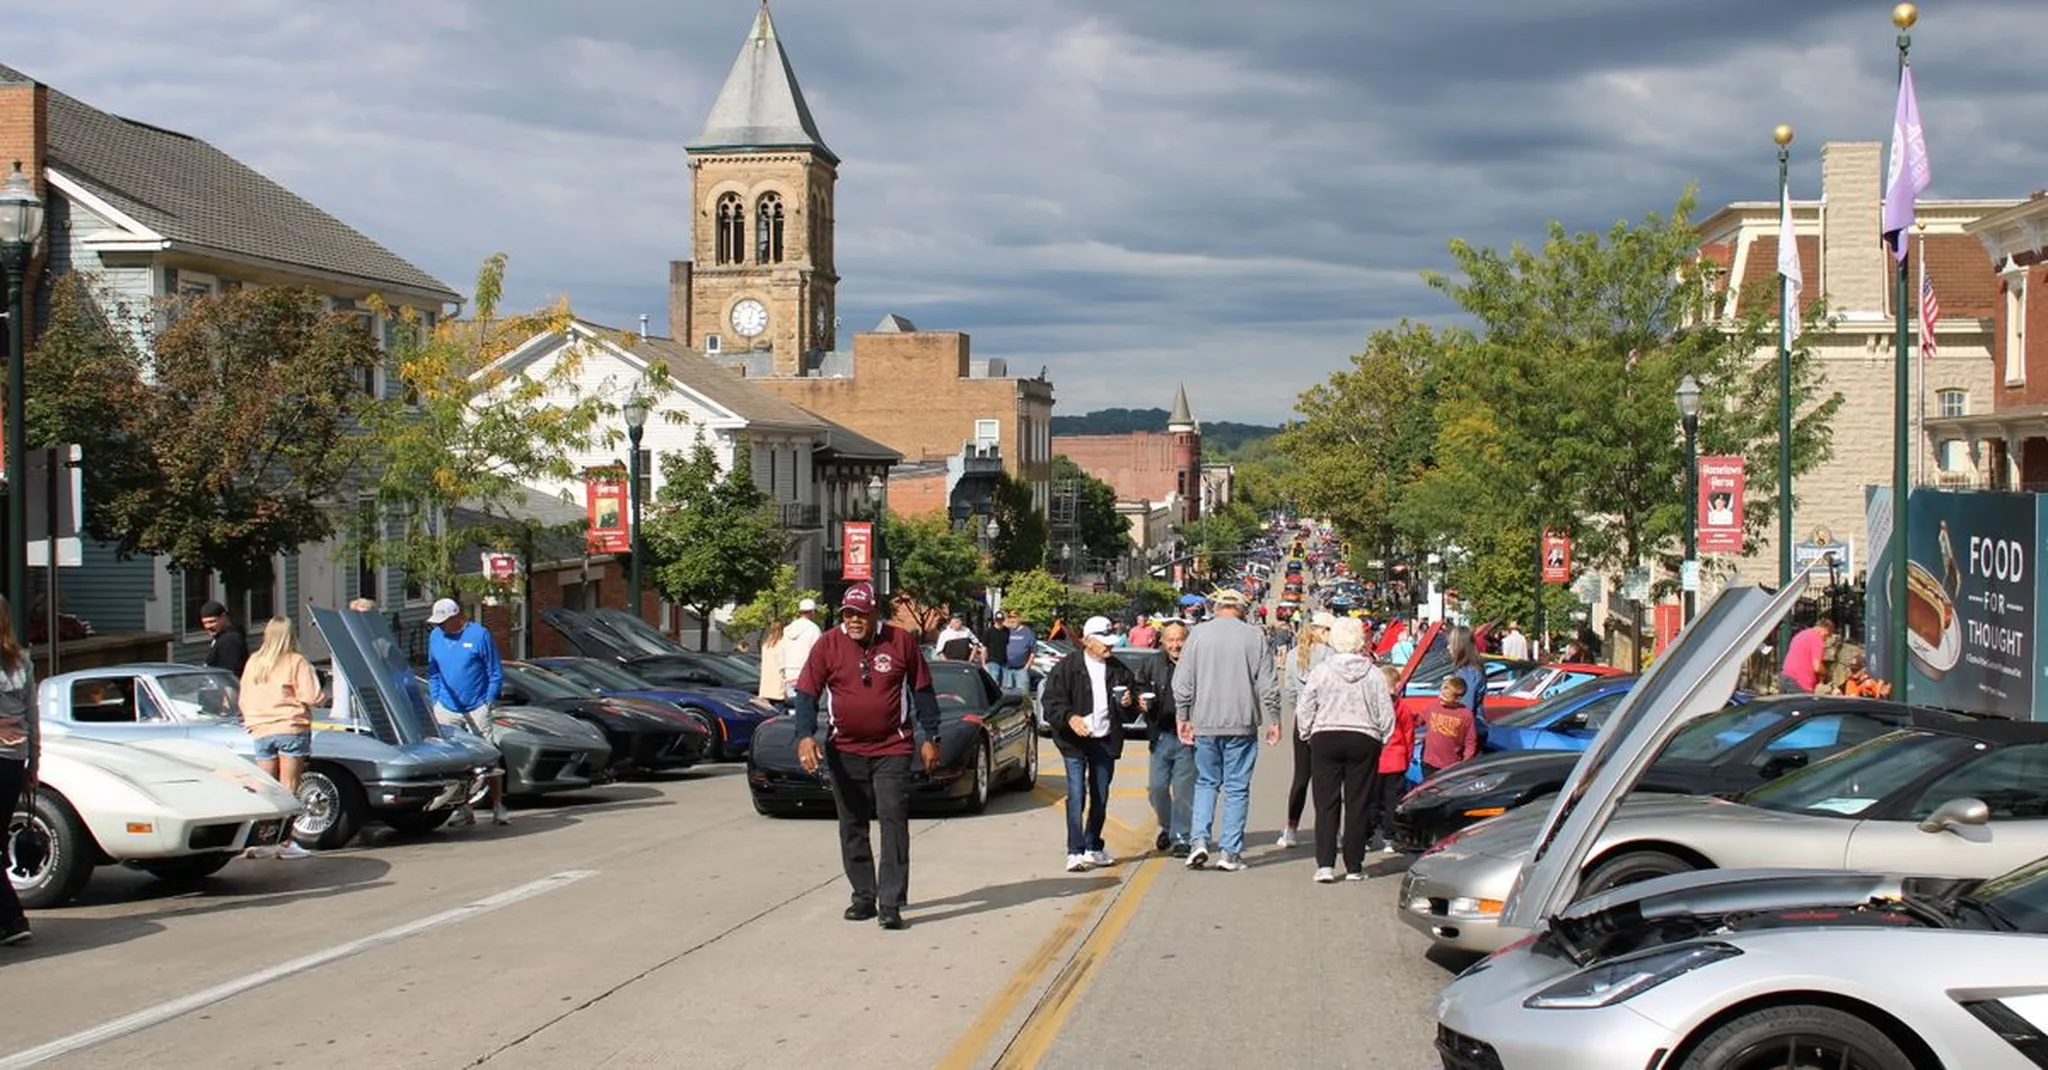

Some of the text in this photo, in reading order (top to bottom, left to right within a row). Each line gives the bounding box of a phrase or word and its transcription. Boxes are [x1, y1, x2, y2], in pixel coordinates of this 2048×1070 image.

[1970, 536, 2023, 582] FOOD
[1984, 591, 2005, 614] FOR
[1967, 619, 2023, 657] THOUGHT
